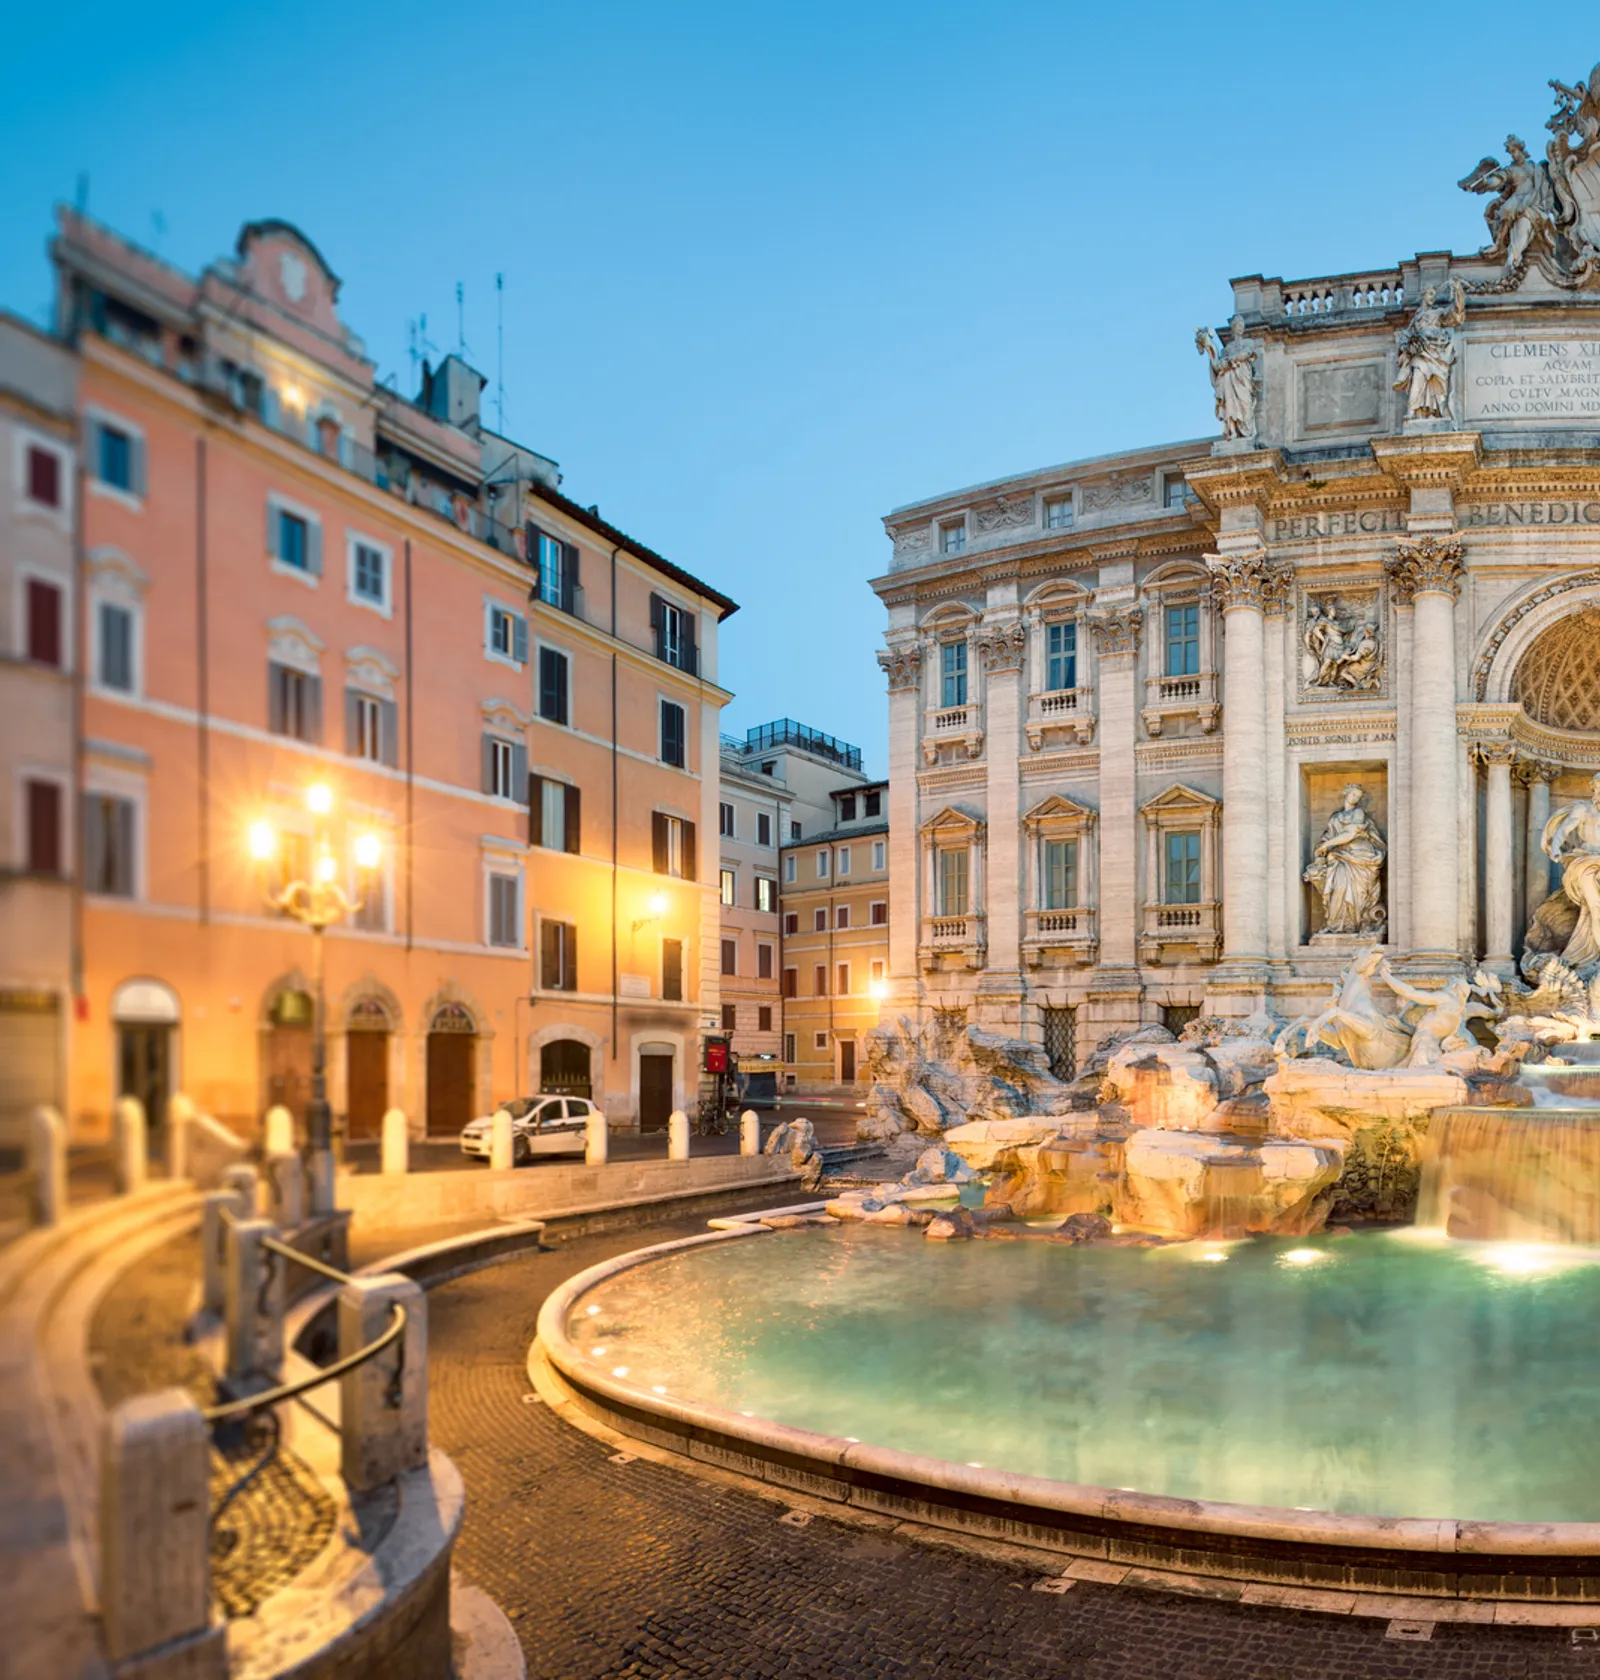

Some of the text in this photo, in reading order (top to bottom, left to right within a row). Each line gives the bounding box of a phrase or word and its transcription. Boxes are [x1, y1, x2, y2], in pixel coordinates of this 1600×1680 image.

[1490, 343, 1569, 358] CLEMENS
[1543, 360, 1591, 373] AQVAM
[1475, 375, 1514, 387] COPIA
[1520, 374, 1534, 385] ET
[1508, 387, 1552, 399] CVLTV
[1481, 402, 1521, 414] ANNO
[1525, 401, 1574, 413] DOMINI
[1288, 735, 1320, 746] POSITIS
[1324, 734, 1352, 744] SIGNIS
